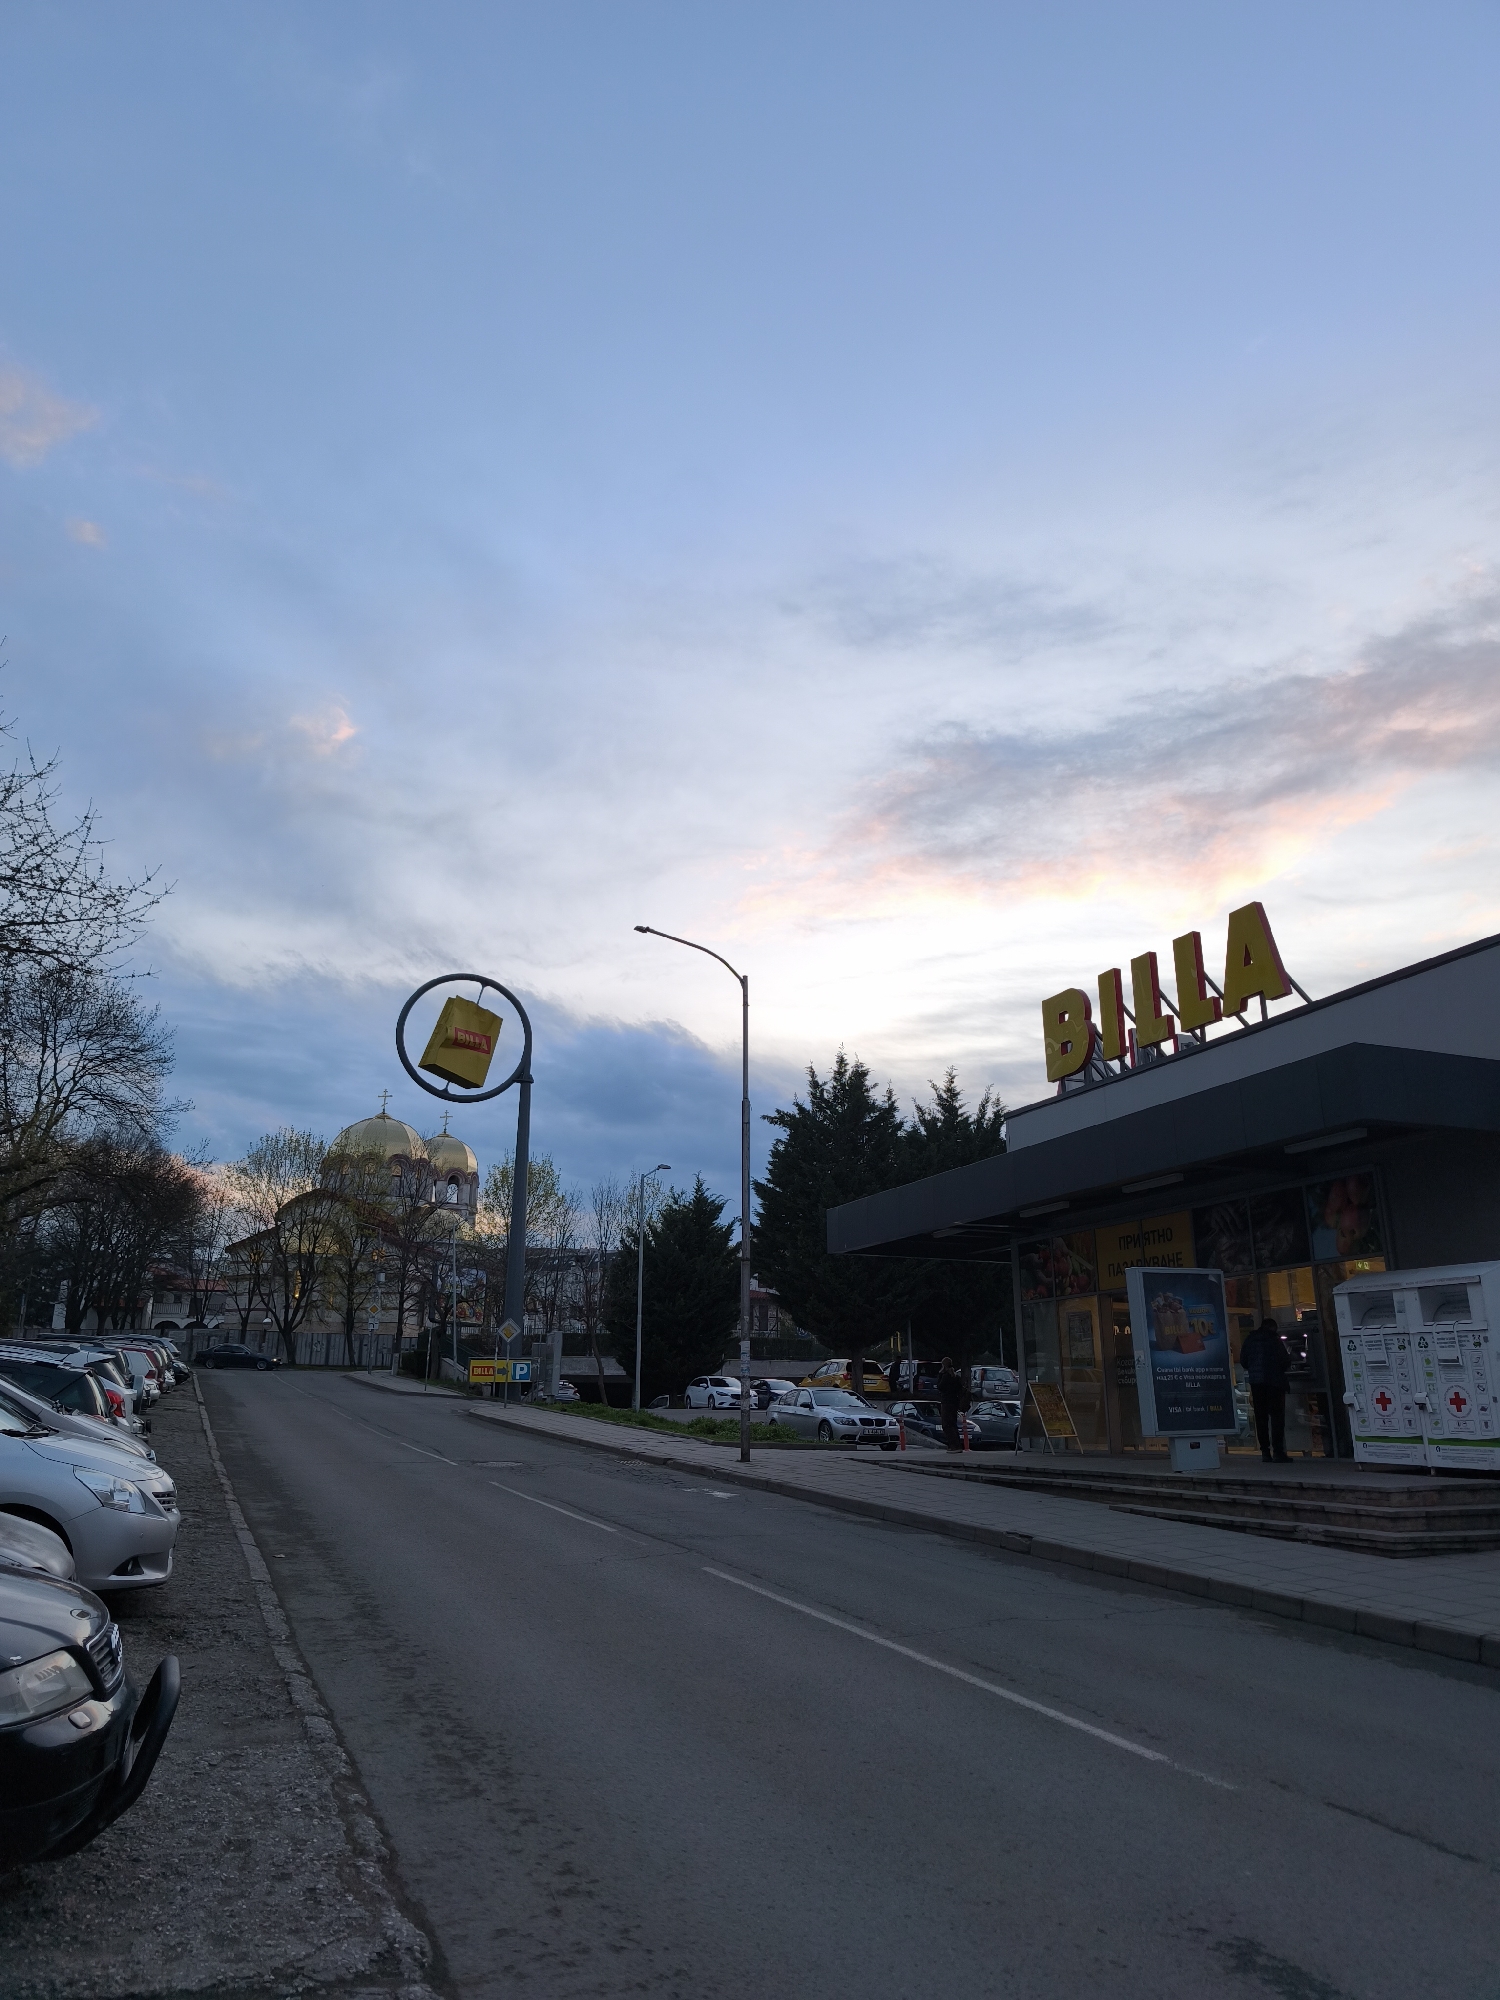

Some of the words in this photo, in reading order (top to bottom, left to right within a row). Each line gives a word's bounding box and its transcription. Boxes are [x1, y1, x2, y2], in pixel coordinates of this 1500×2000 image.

[1042, 901, 1293, 1083] BILLA
[456, 1030, 489, 1051] BILLA
[1118, 1227, 1174, 1251] ПРИЯТНО
[473, 1367, 494, 1375] BILLA
[515, 1363, 528, 1380] P
